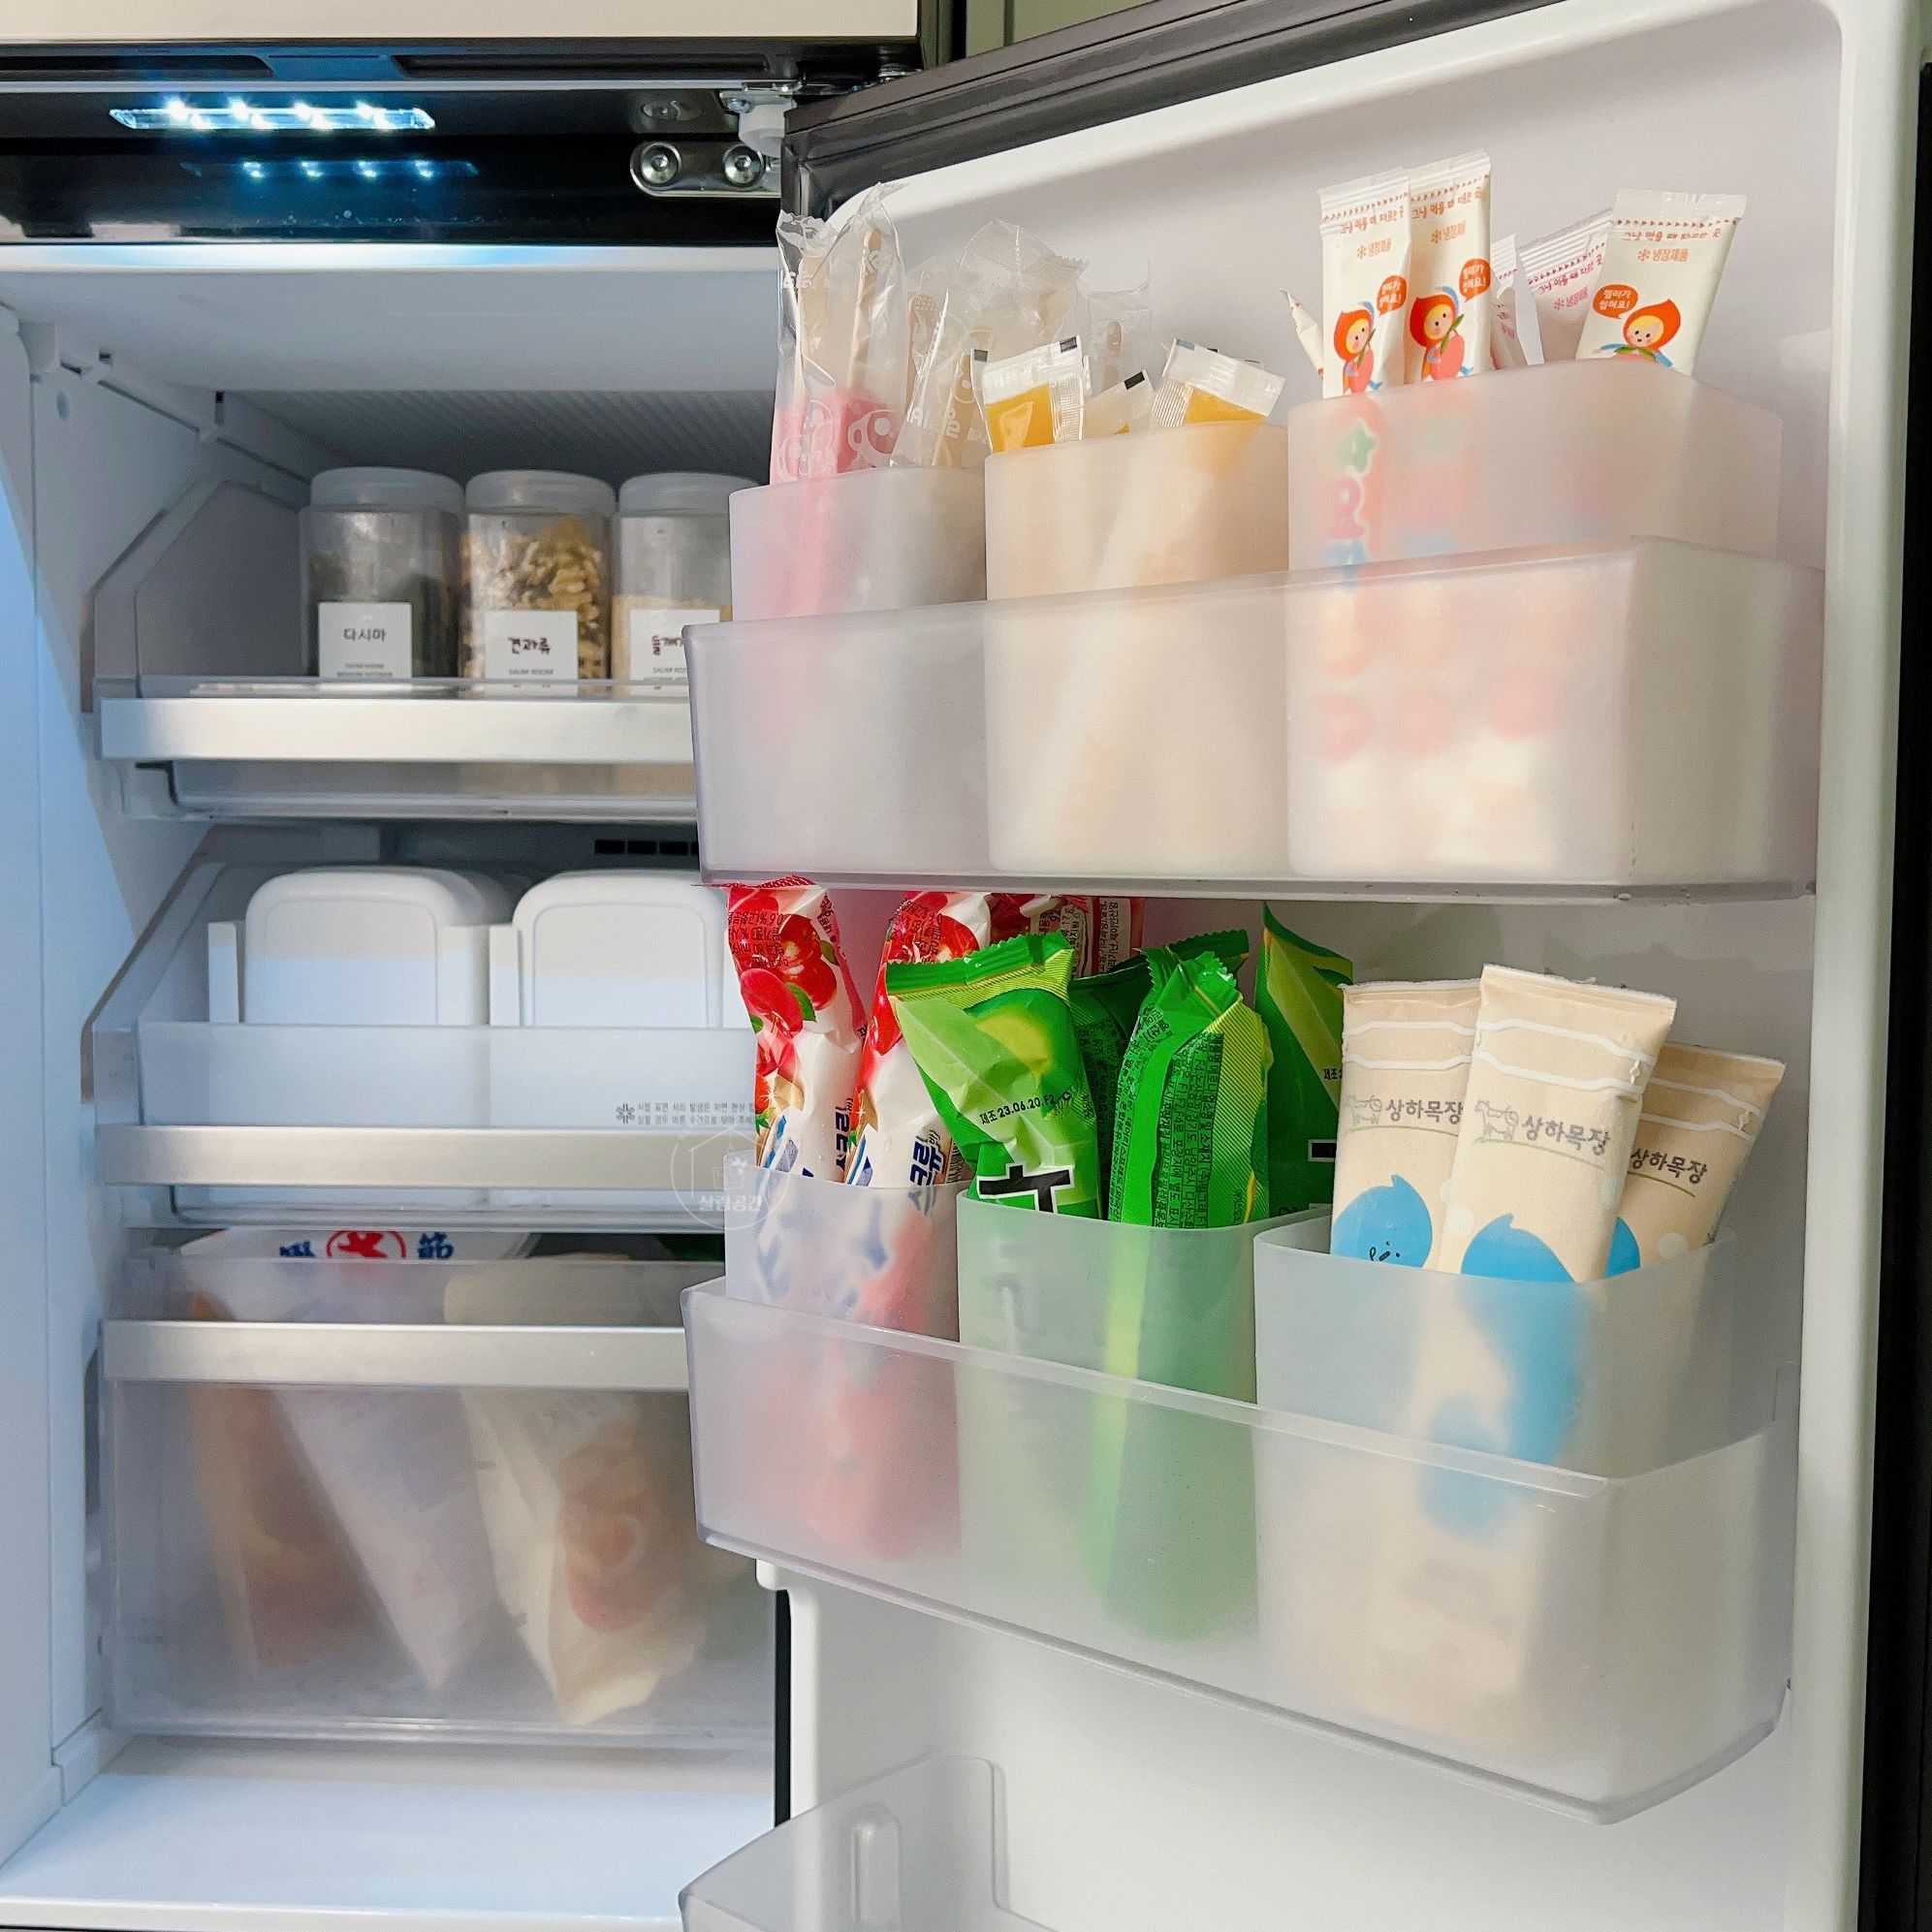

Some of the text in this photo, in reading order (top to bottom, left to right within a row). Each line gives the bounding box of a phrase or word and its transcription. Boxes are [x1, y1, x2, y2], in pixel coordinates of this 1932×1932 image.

[979, 1109, 998, 1124] 제조
[1385, 1098, 1464, 1125] 상하목장
[1521, 1116, 1611, 1156] 상하목장
[1631, 1148, 1708, 1185] 상하목장
